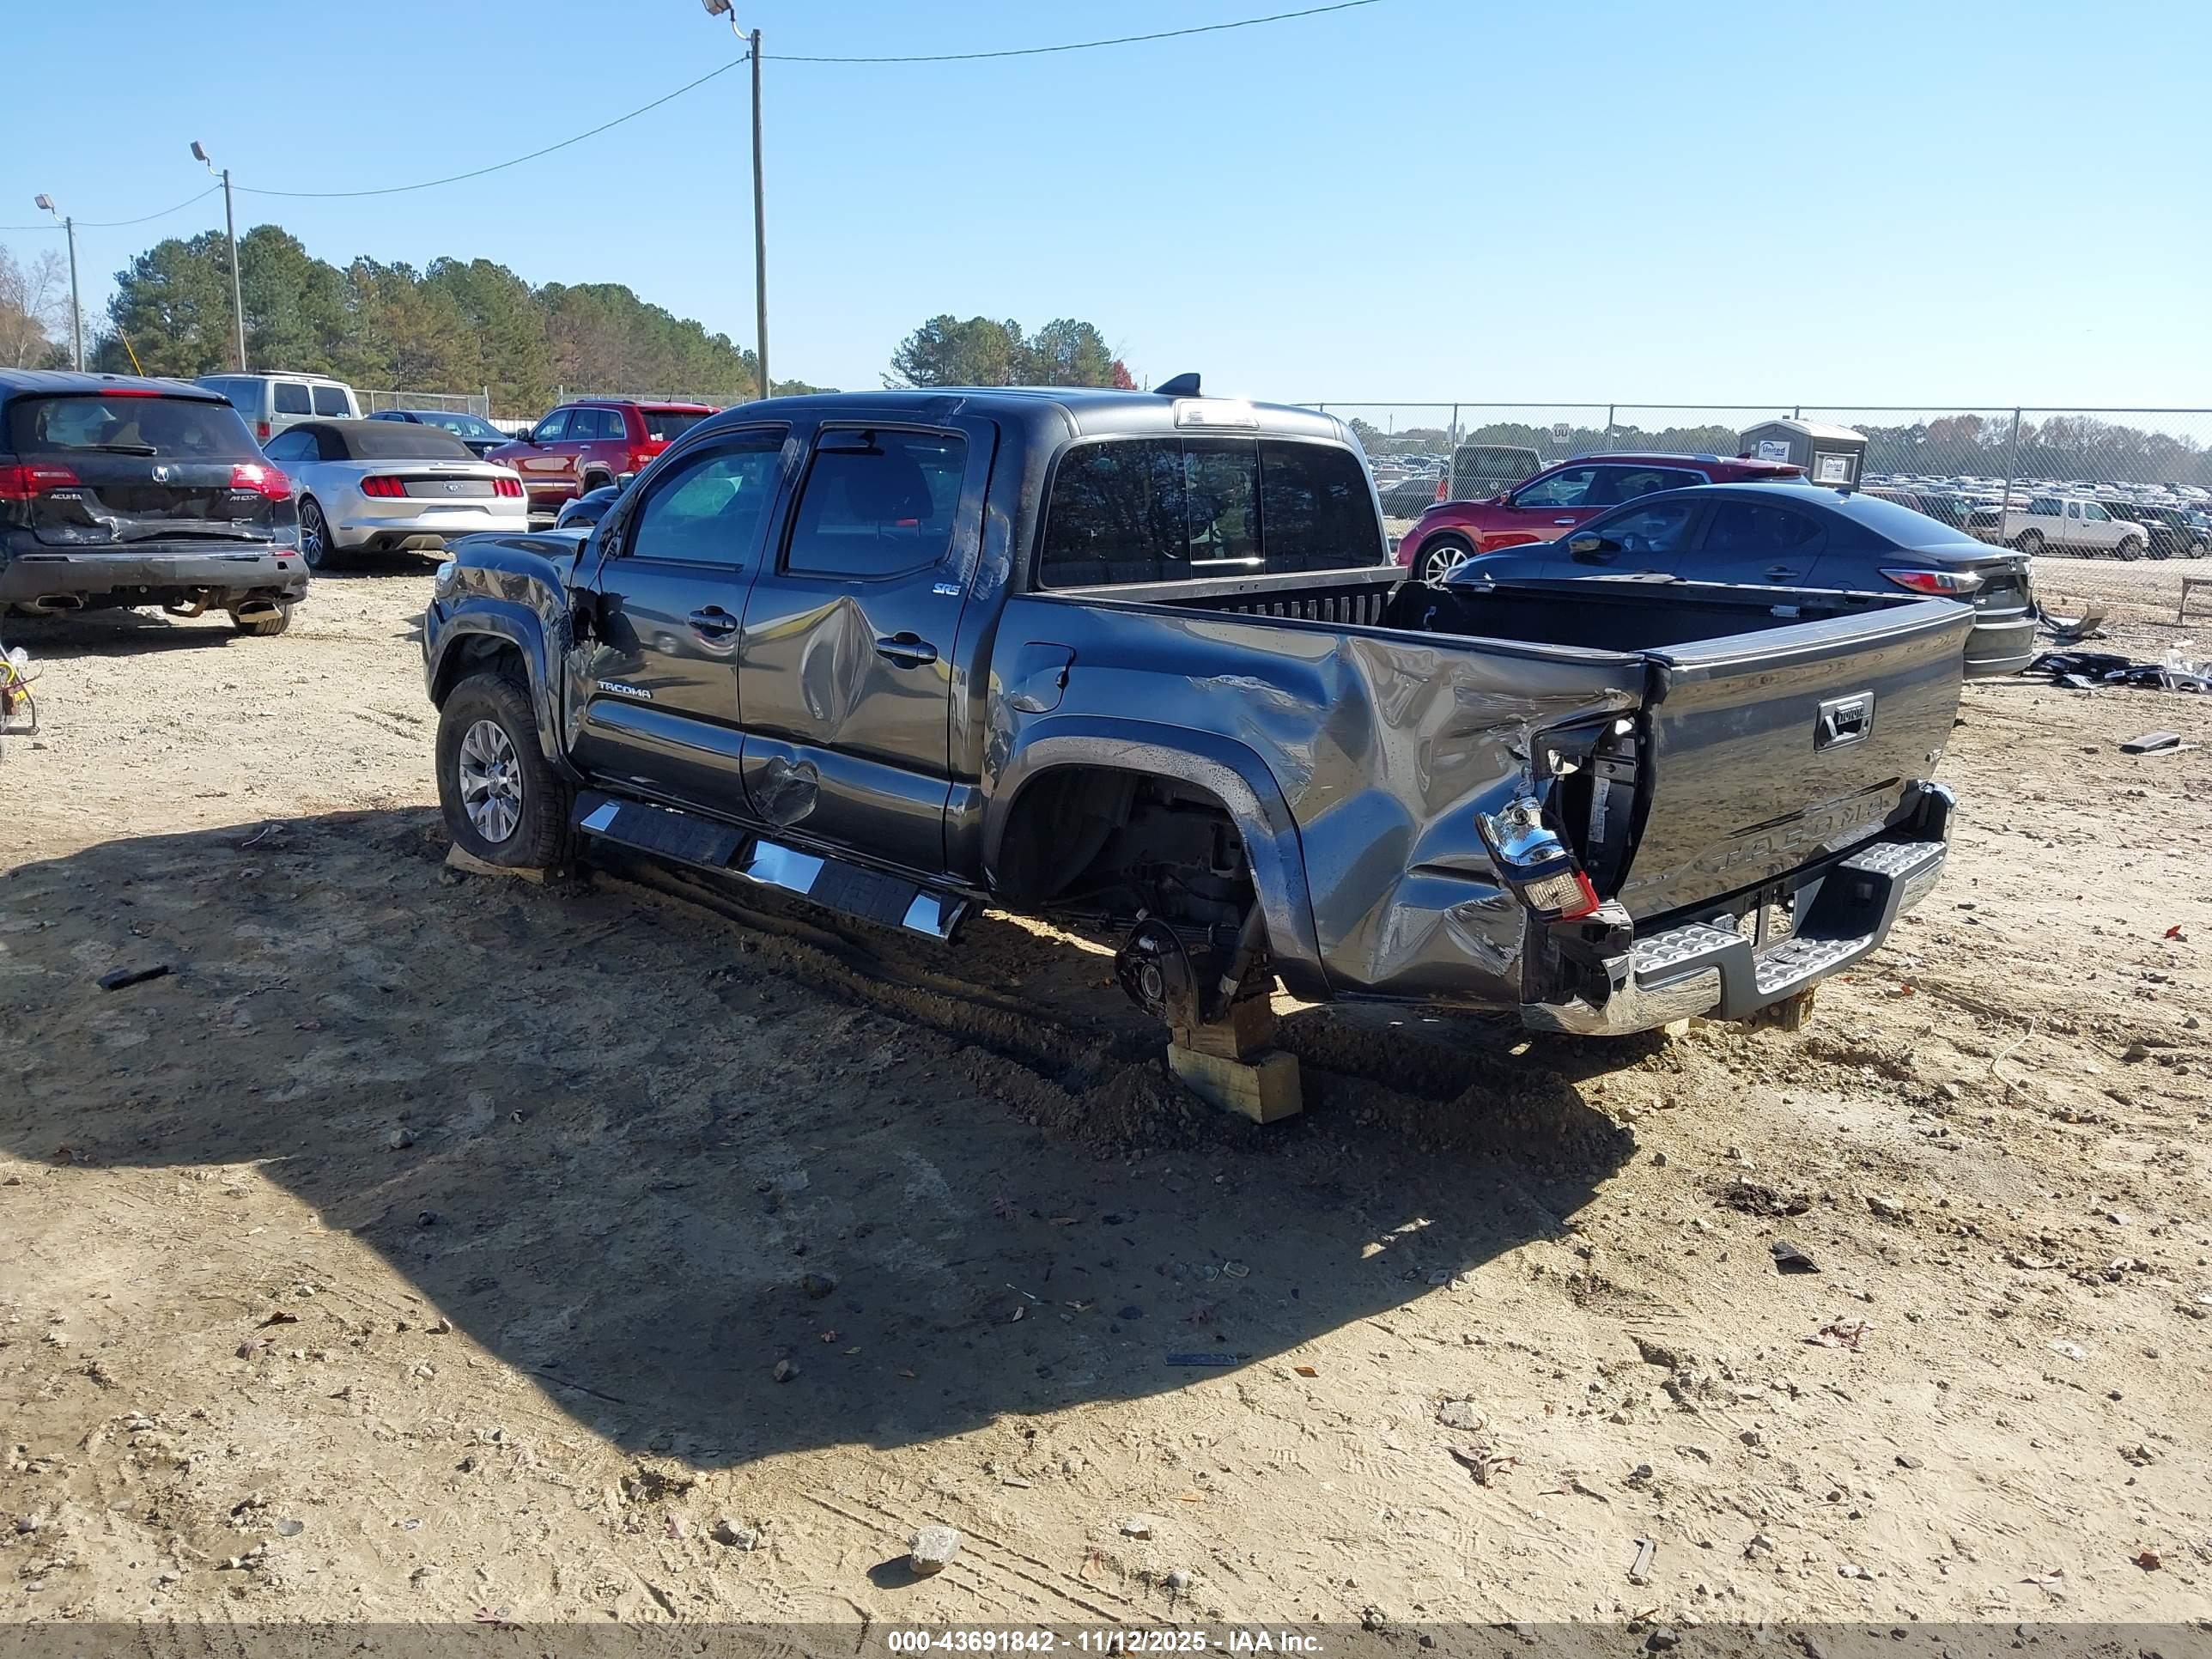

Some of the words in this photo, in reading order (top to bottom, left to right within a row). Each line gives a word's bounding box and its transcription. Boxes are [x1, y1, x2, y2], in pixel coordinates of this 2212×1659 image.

[933, 582, 962, 596] SR5
[597, 680, 652, 699] TACOMA
[1711, 793, 1884, 871] TACOMA
